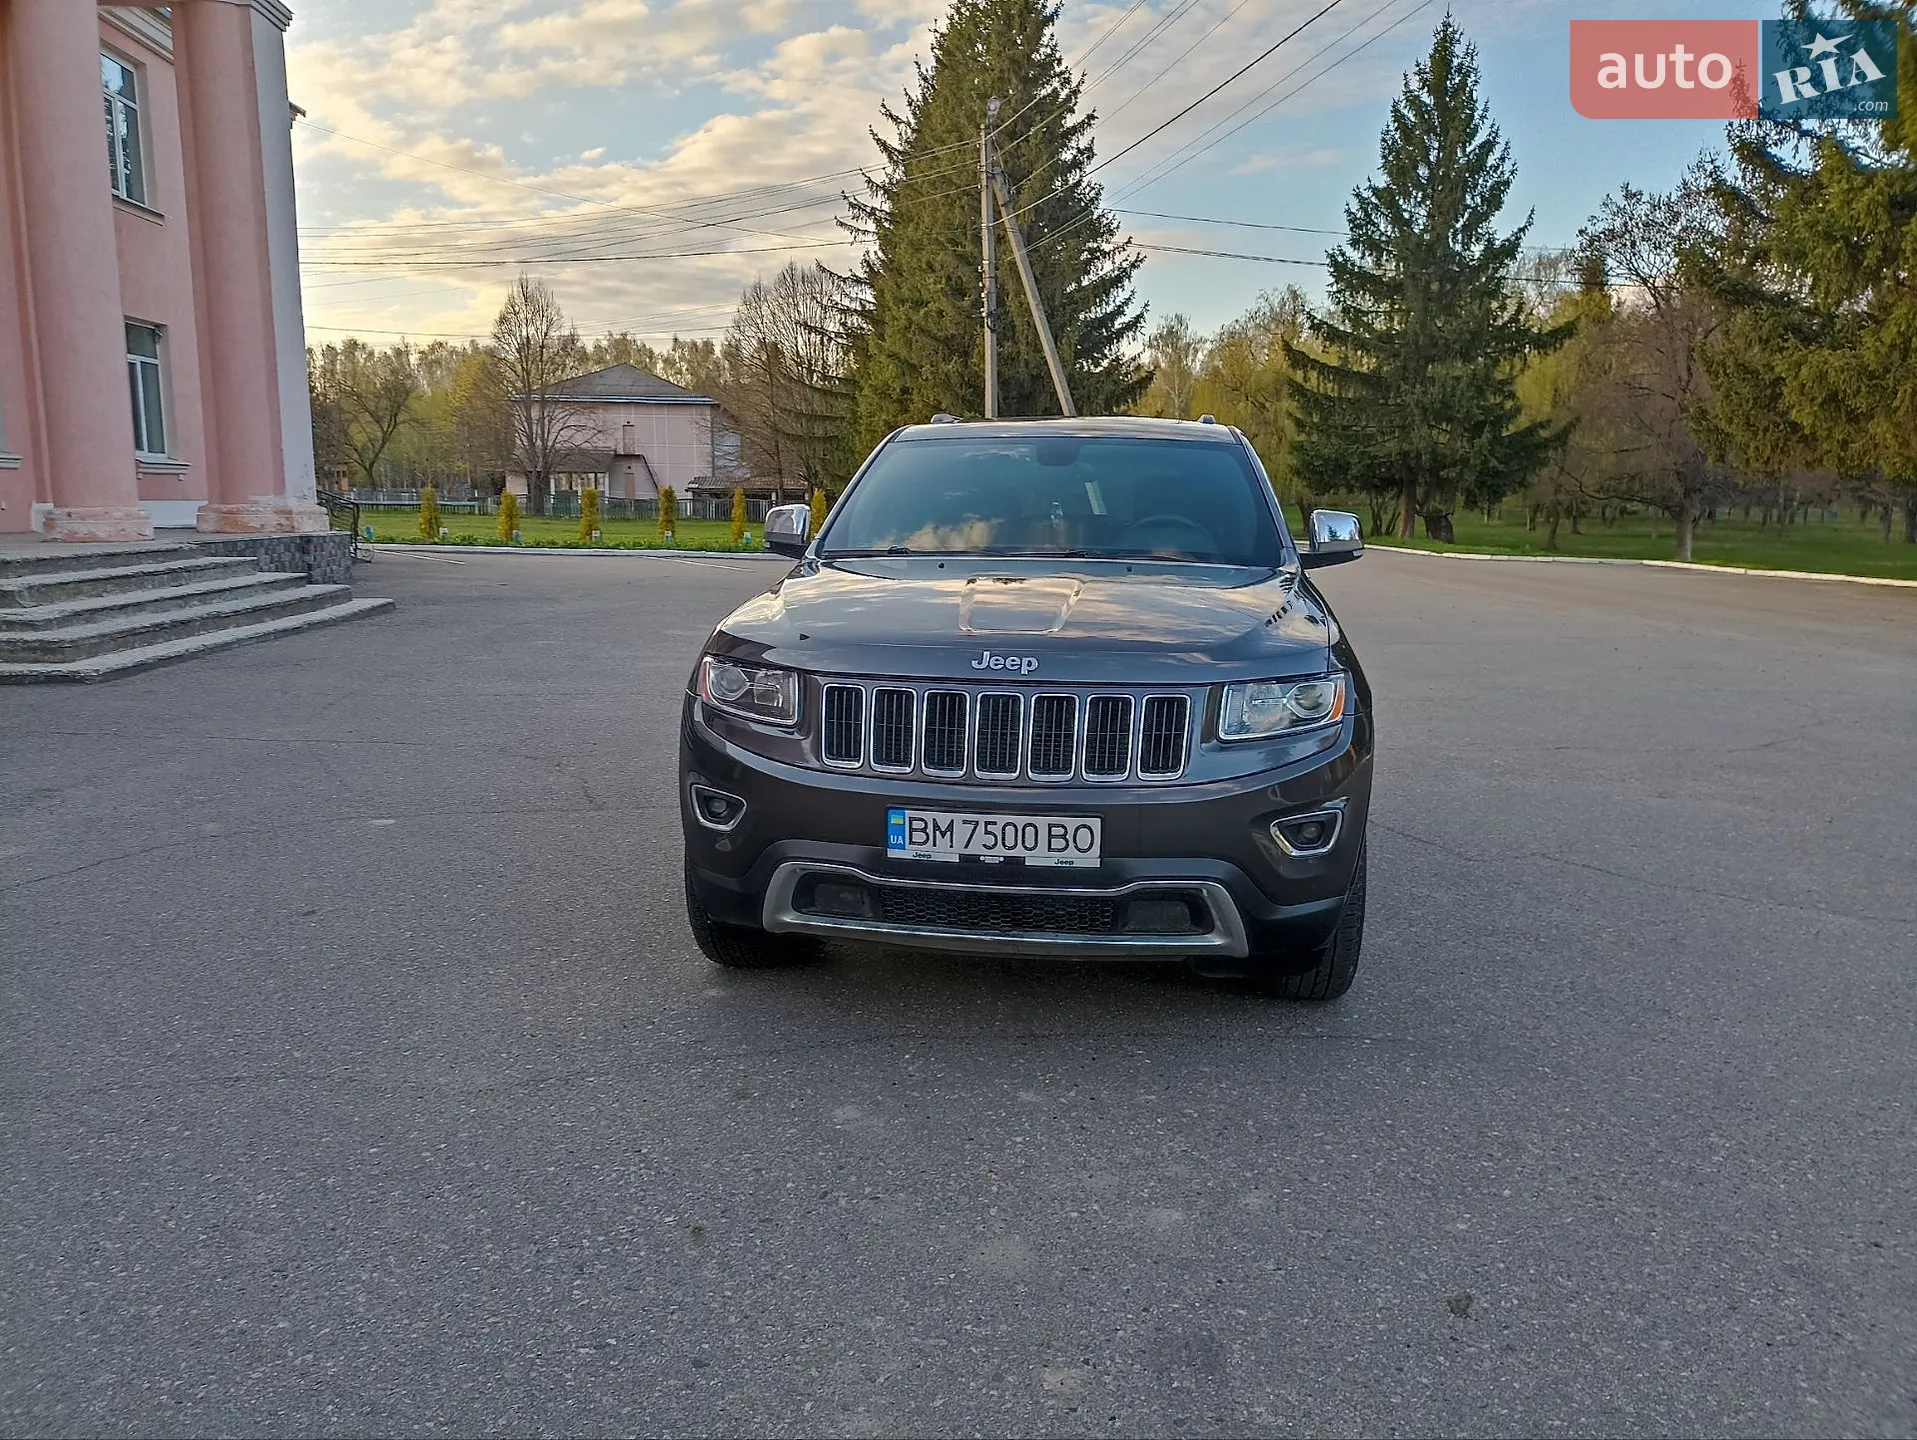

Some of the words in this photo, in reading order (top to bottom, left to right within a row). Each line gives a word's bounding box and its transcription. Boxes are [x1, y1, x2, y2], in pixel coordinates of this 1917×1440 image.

[971, 650, 1039, 675] Jeep
[890, 835, 904, 845] UA
[912, 850, 932, 860] Jeep
[1054, 858, 1074, 867] Jeep
